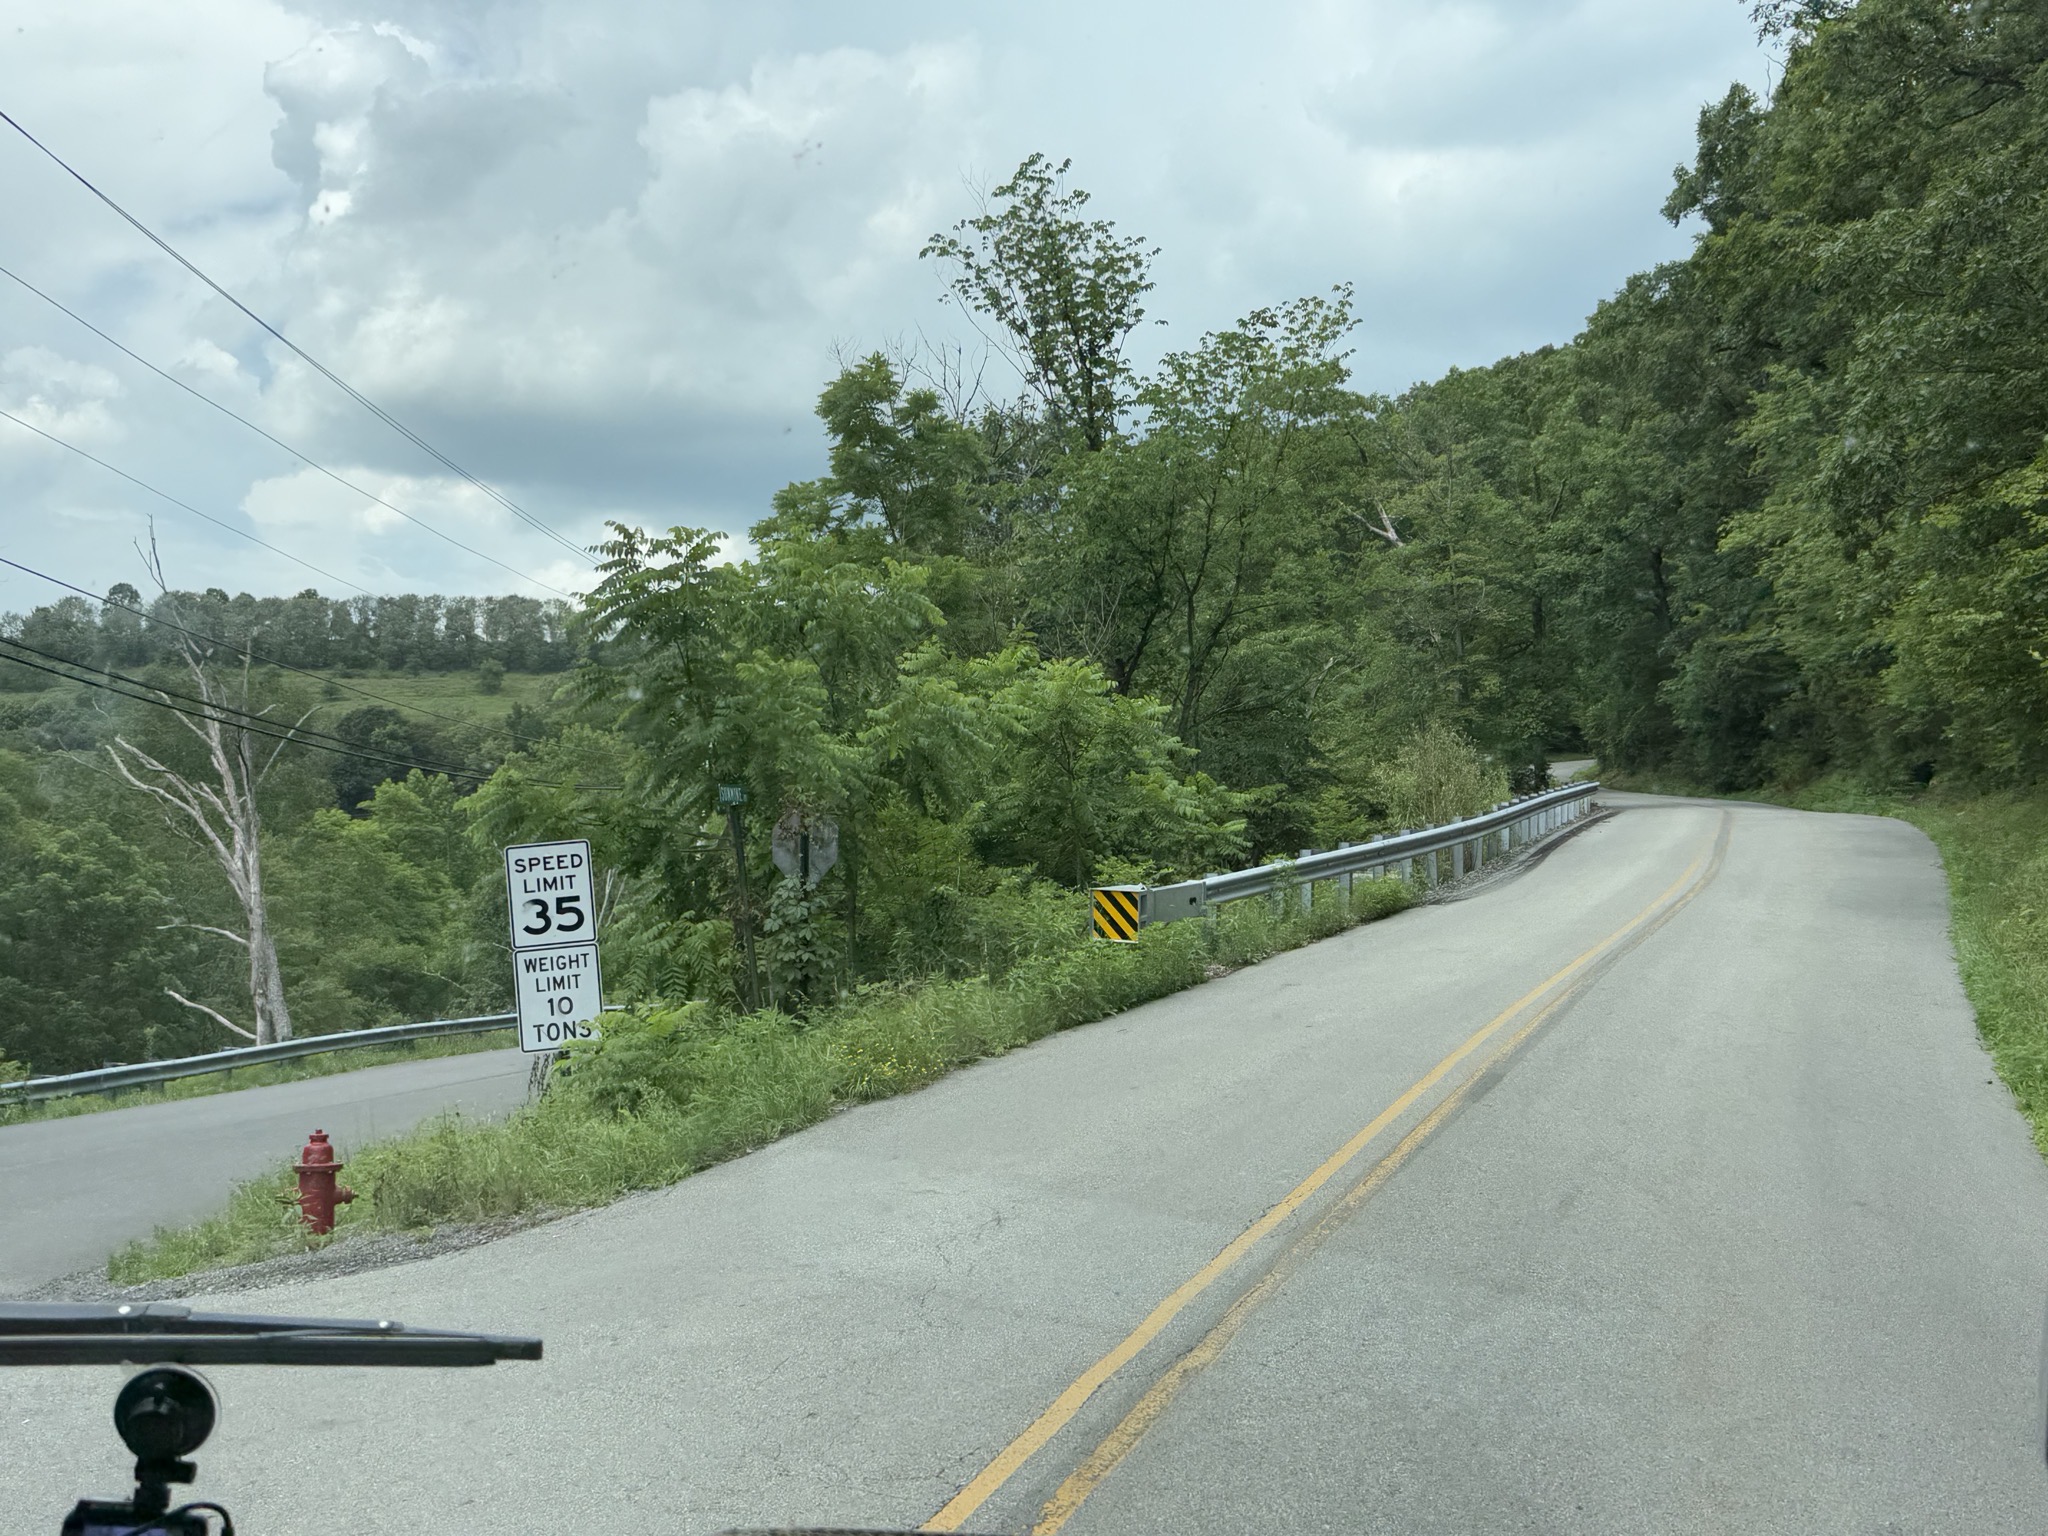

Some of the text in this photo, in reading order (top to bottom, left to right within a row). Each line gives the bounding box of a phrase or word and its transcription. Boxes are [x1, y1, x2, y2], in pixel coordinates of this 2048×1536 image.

[514, 853, 583, 873] SPEED
[523, 875, 576, 893] LIMIT
[522, 895, 585, 935] 35
[524, 953, 590, 973] WEIGHT
[535, 974, 581, 993] LIMIT
[547, 996, 574, 1017] 10
